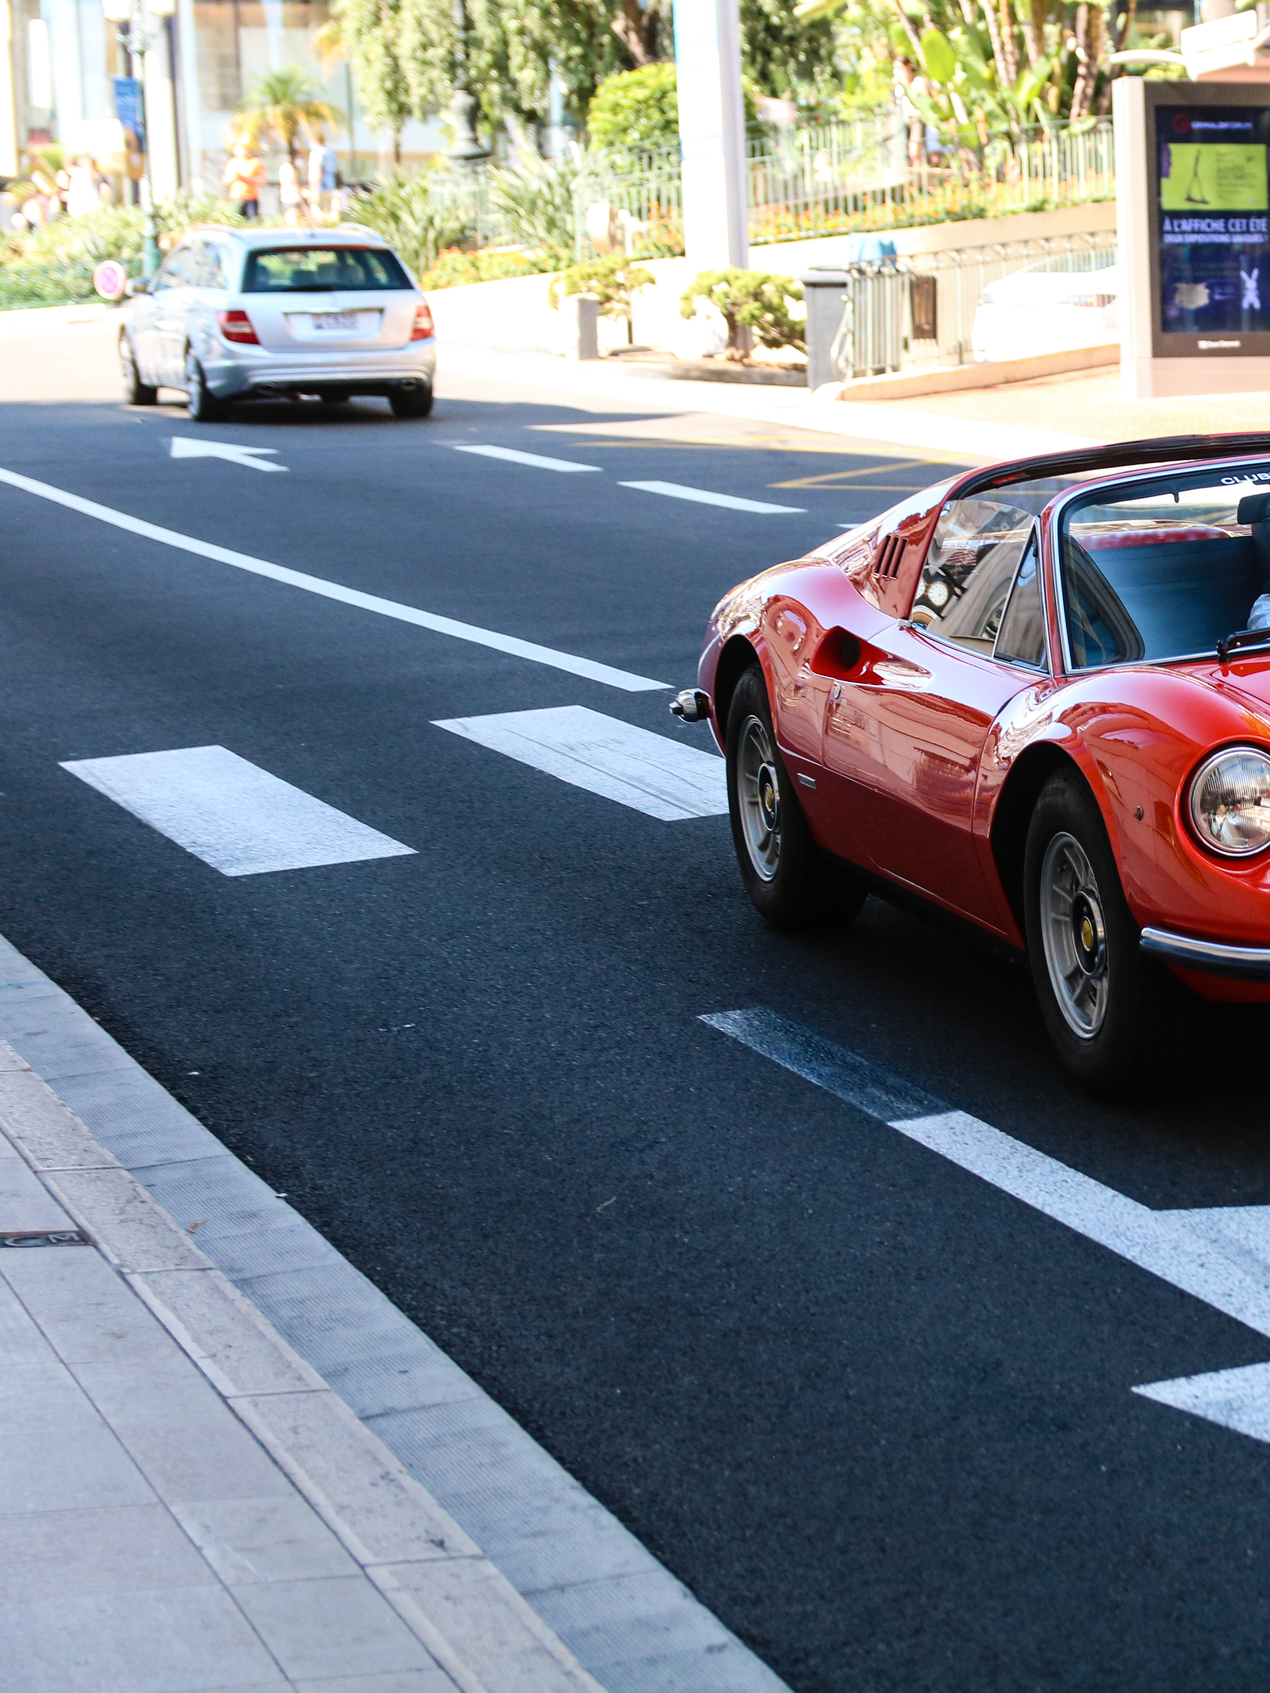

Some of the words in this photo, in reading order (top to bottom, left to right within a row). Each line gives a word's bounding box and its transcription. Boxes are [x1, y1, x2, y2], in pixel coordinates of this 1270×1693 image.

[1173, 217, 1226, 232] L'AFFICHE
[1227, 217, 1247, 232] CET
[1248, 215, 1267, 232] ÉTÉ
[1220, 472, 1270, 485] CLUB
